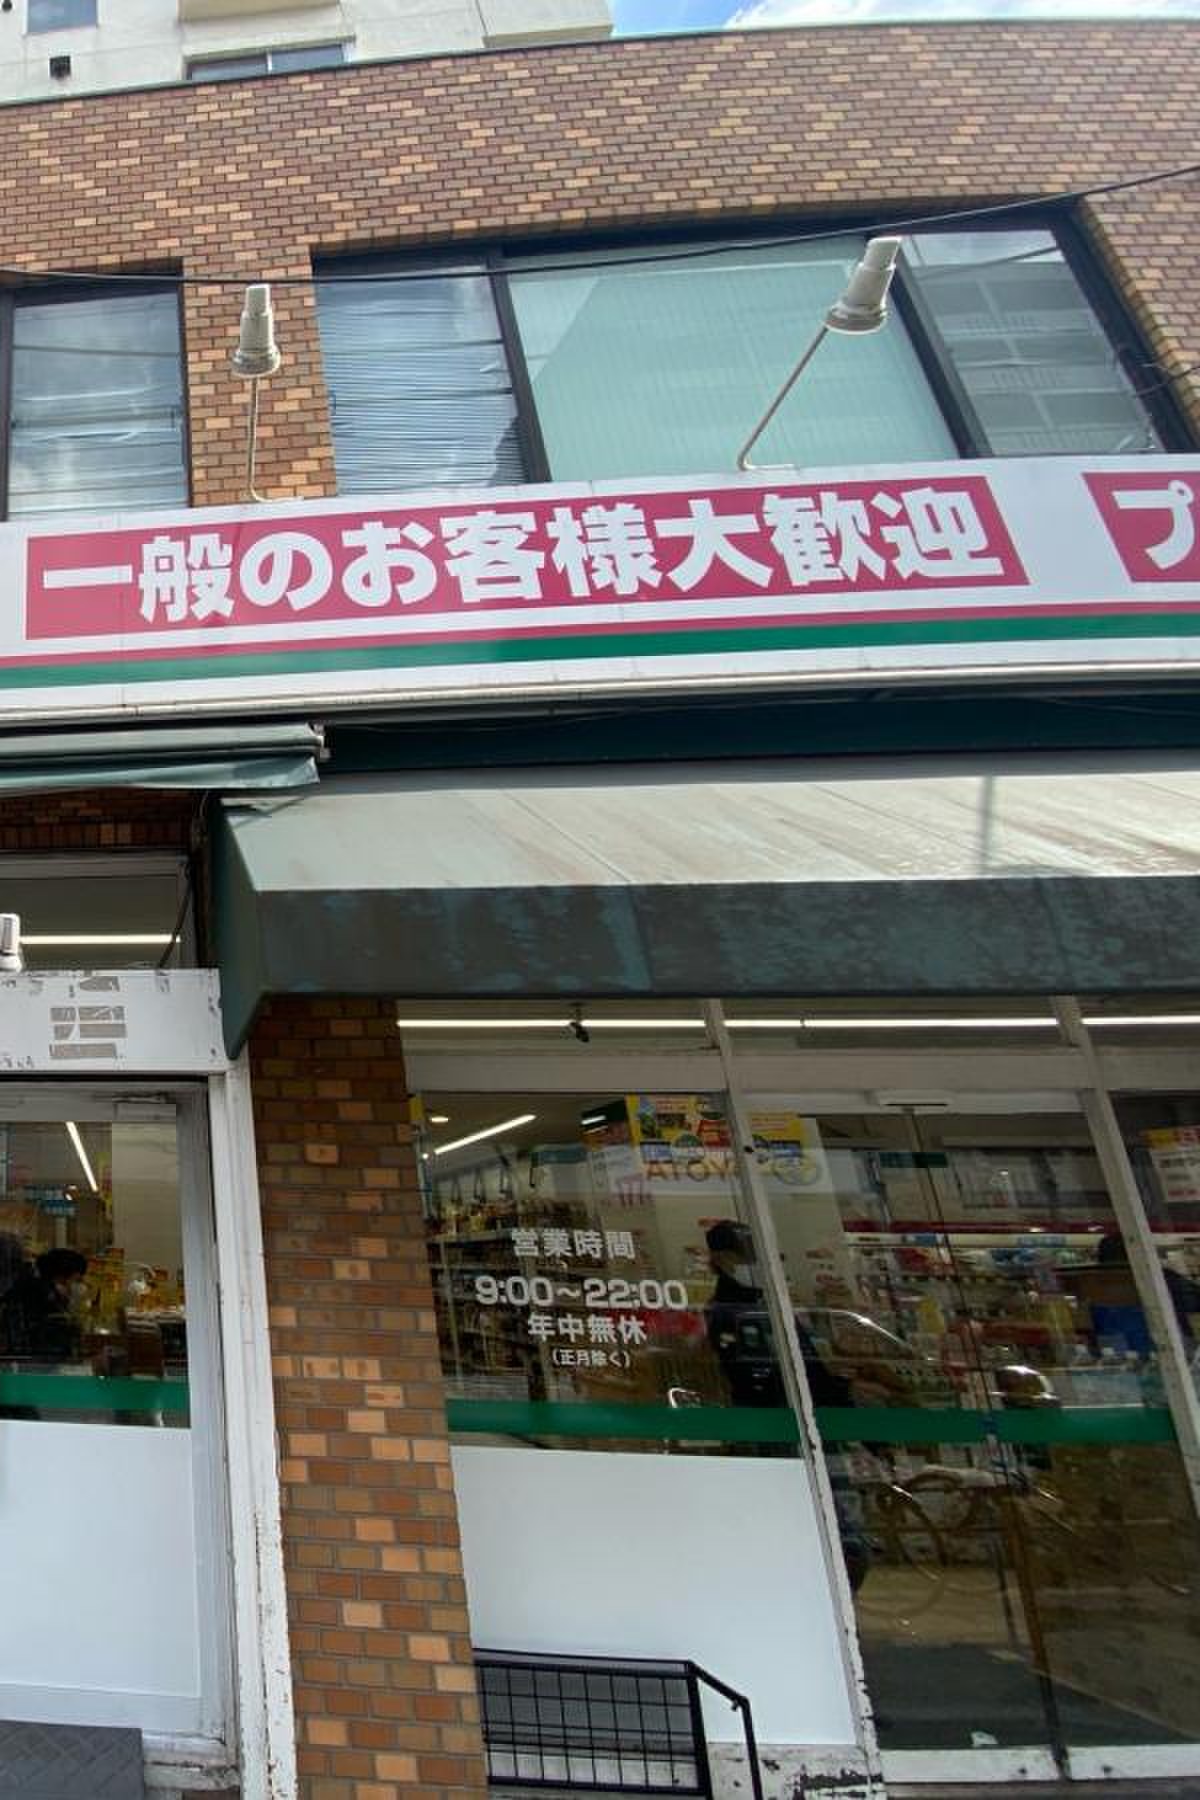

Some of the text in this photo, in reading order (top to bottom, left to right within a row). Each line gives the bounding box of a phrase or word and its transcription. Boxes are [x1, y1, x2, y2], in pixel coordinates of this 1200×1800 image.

[43, 487, 1004, 622] 一般のお客様大歓迎
[1112, 479, 1195, 570] プ
[511, 1228, 636, 1260] 営業時間
[527, 1313, 647, 1345] 年中無休
